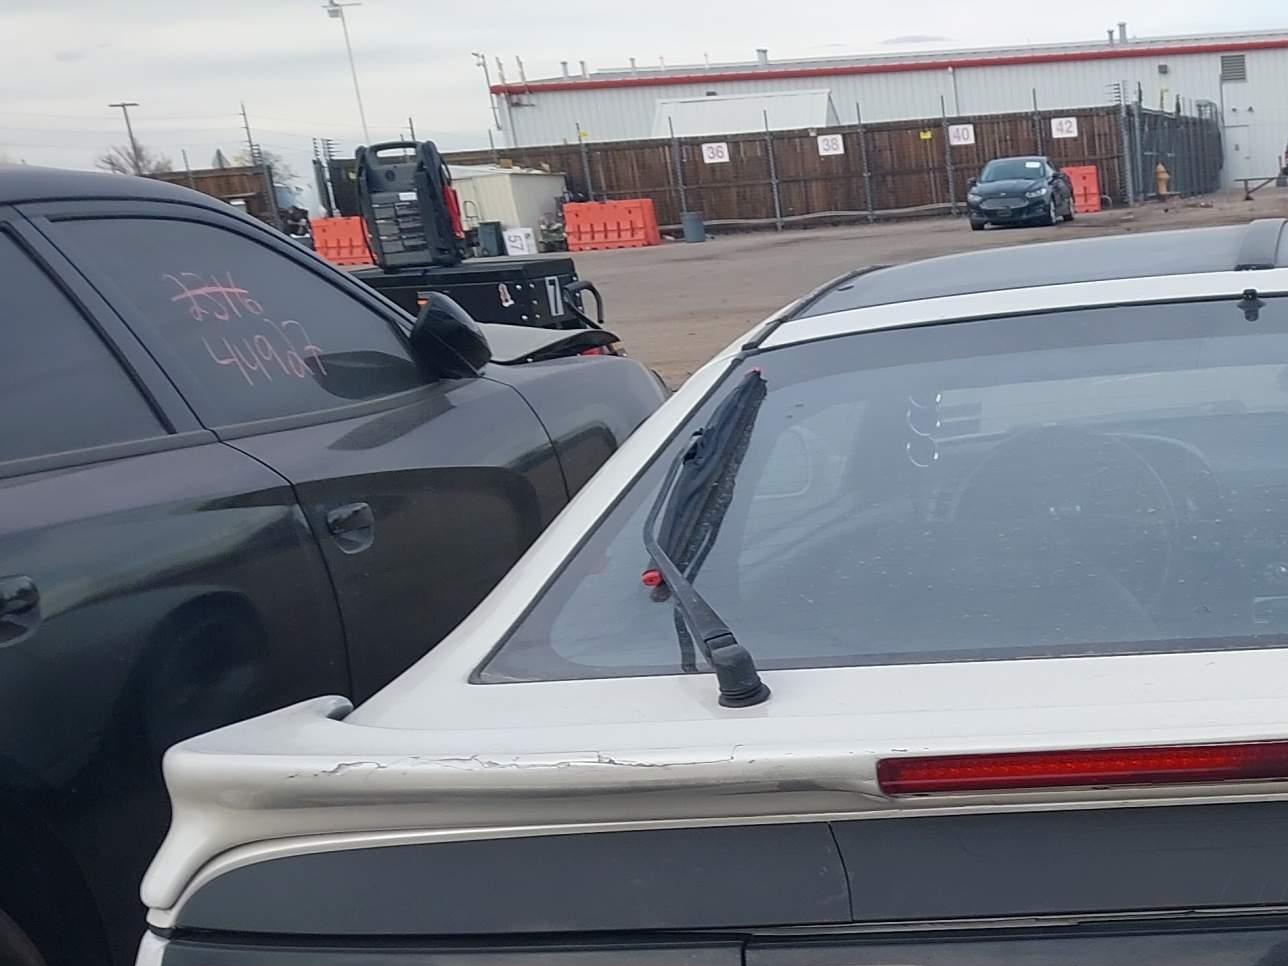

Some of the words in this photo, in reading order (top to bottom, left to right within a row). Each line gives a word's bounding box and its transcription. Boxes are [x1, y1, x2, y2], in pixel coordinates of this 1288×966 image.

[1056, 120, 1073, 134] 42
[953, 127, 970, 142] 40
[822, 137, 839, 151] 38
[706, 145, 725, 159] 36
